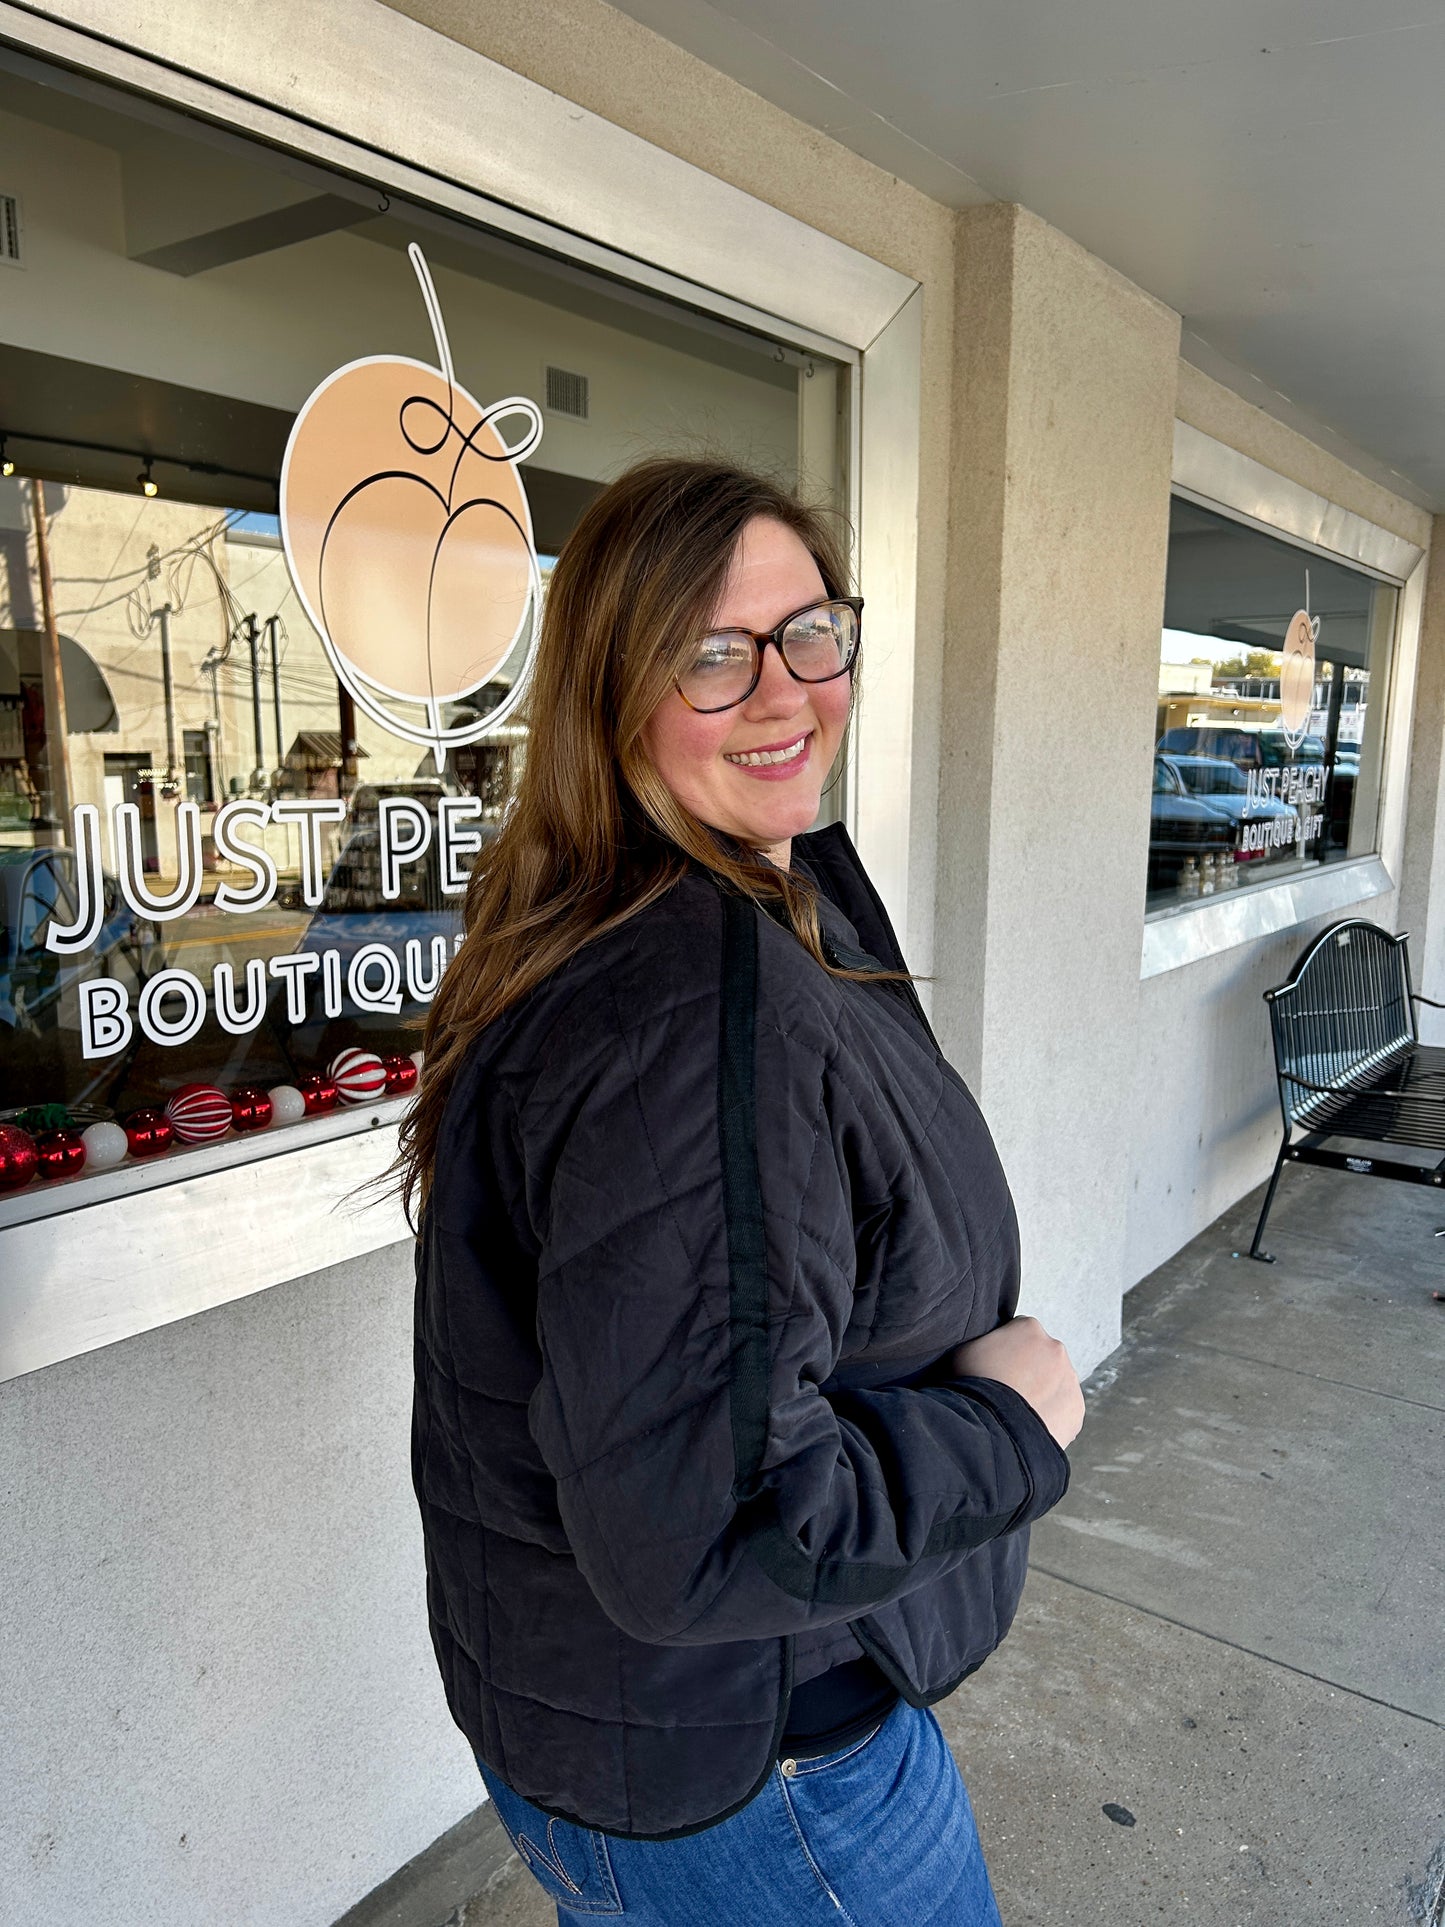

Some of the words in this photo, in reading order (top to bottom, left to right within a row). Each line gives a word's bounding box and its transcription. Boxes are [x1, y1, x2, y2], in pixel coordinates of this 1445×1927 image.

[1241, 817, 1294, 853] BOUTIQUE
[1304, 814, 1324, 840] GIFT
[1242, 767, 1280, 818] JUST
[1281, 765, 1330, 805] PEACHY
[45, 798, 347, 955] JUST
[378, 796, 483, 900] PE
[78, 932, 468, 1060] BOUTIQU
